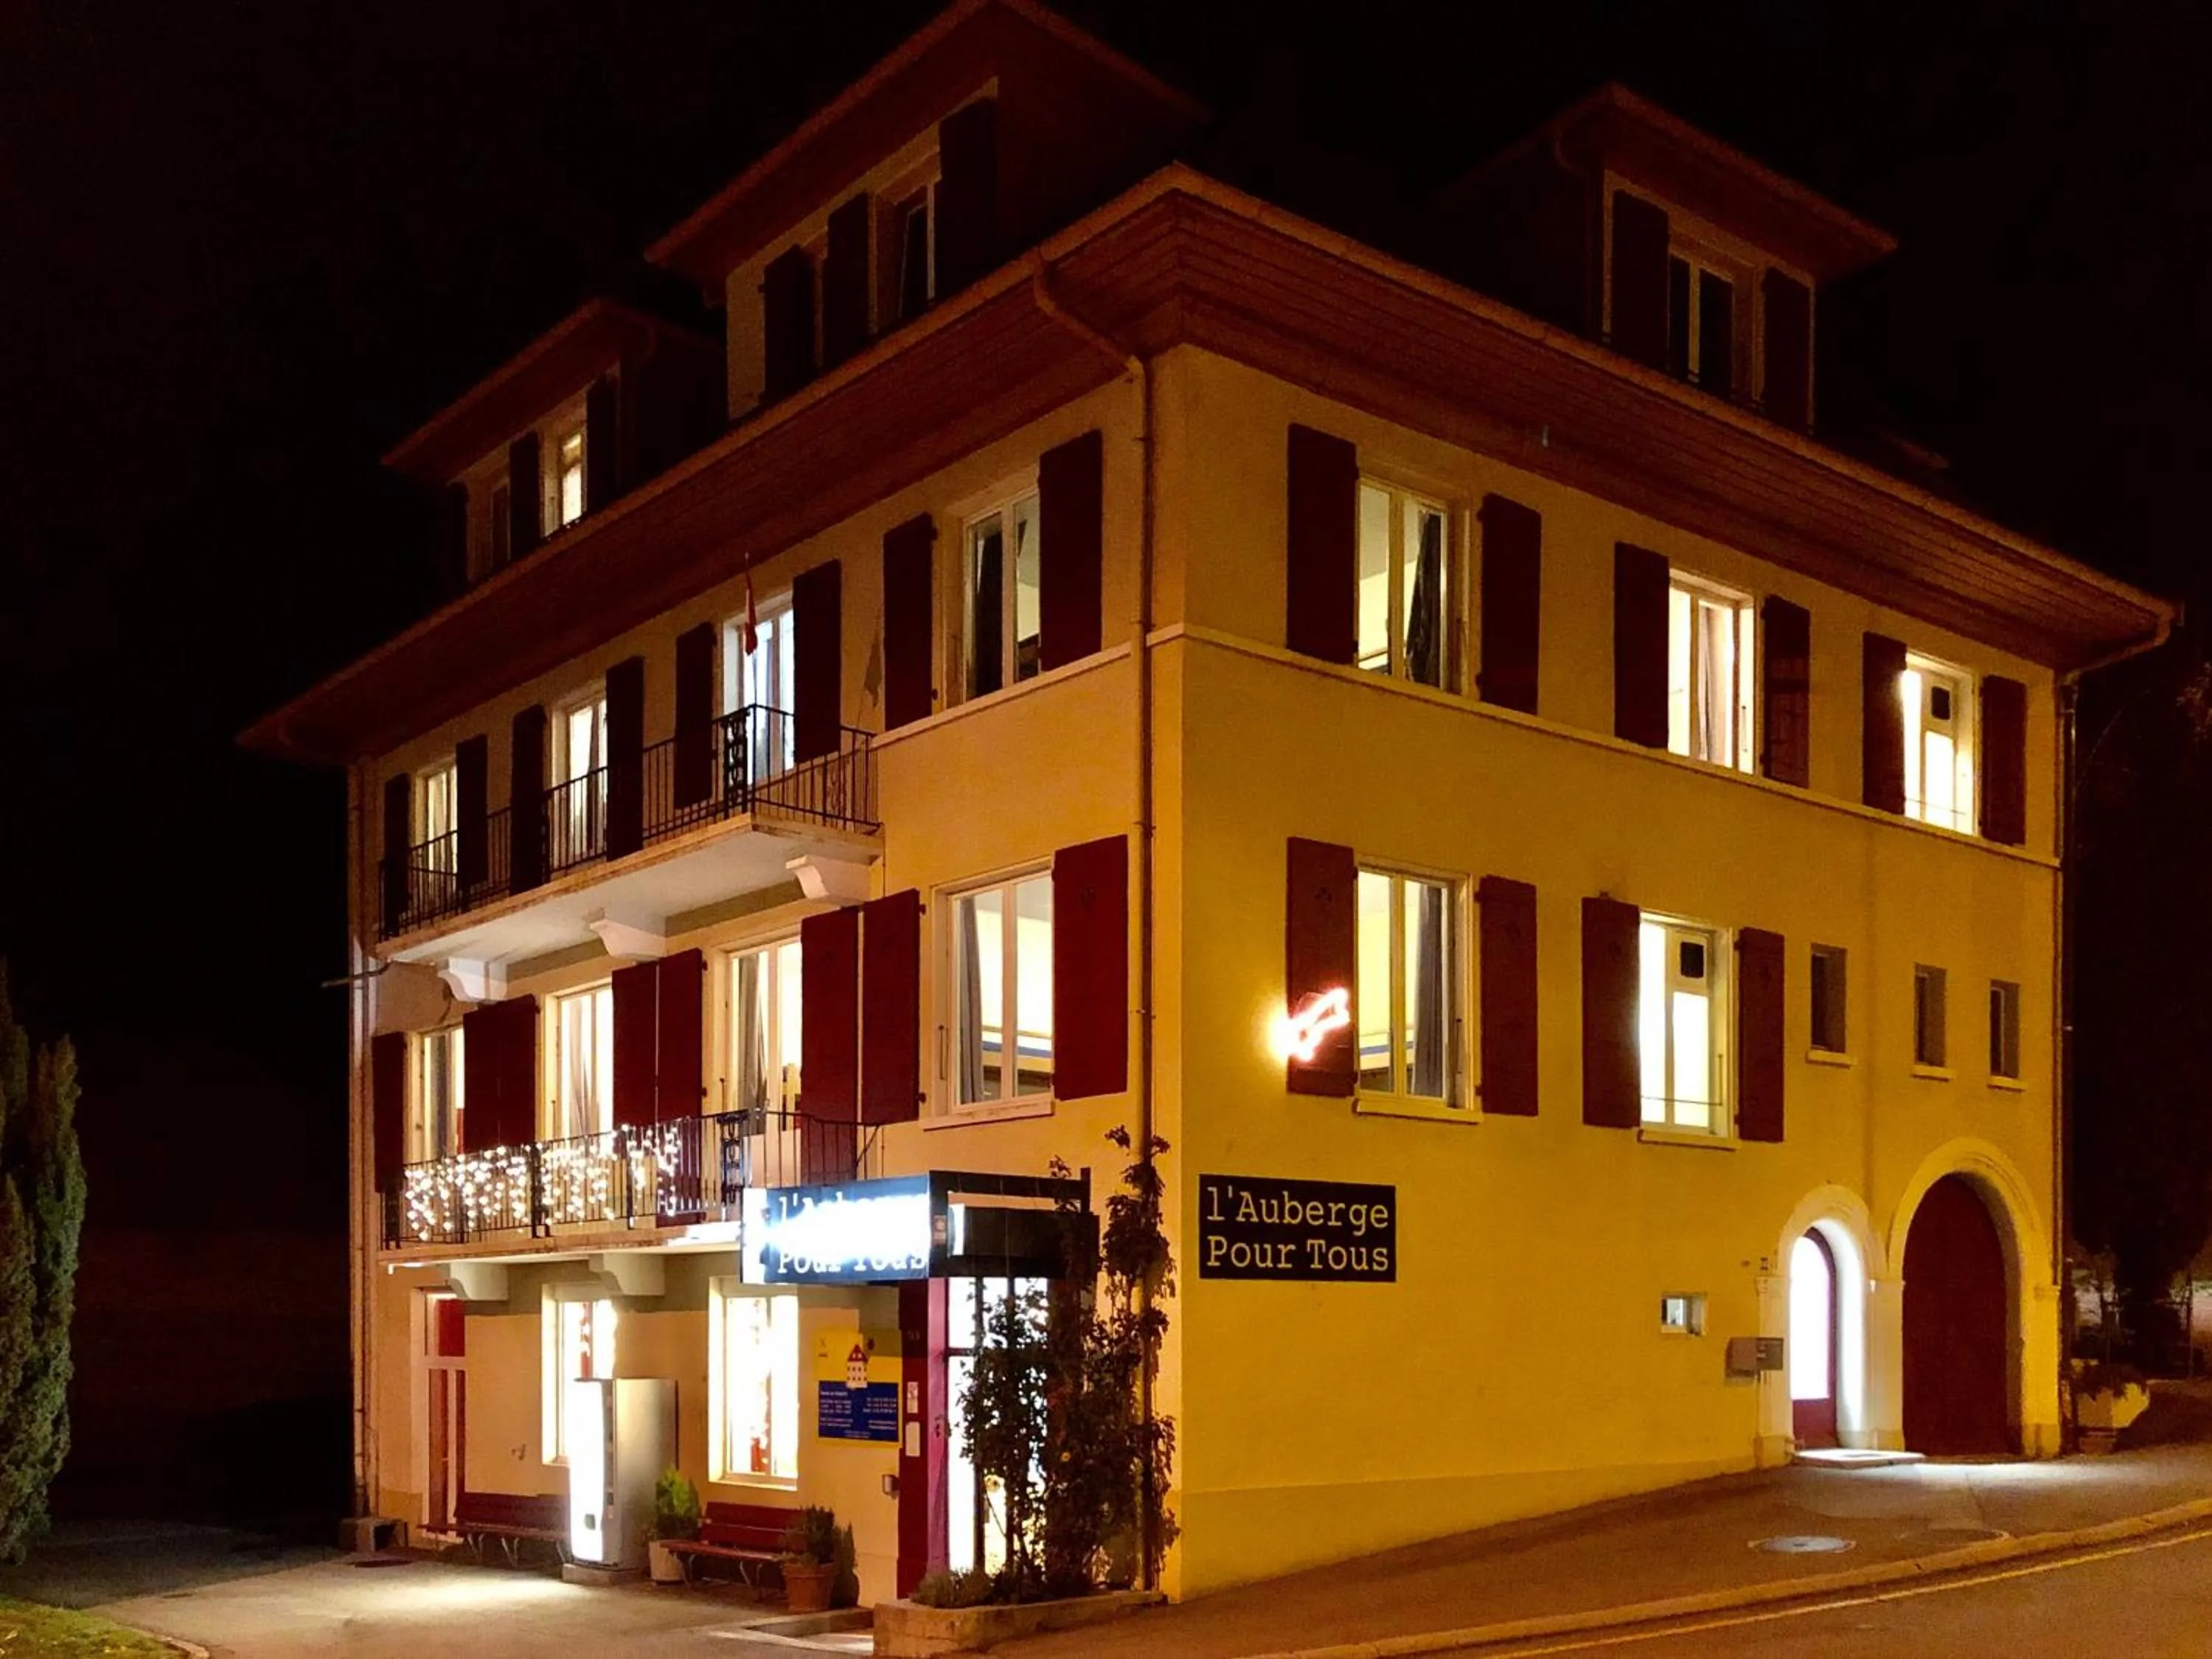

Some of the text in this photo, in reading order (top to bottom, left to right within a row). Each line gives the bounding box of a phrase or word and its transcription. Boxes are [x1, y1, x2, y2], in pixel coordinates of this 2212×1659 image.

[1206, 1185, 1389, 1237] l'Auberge
[778, 1247, 842, 1273] Pou
[1206, 1235, 1389, 1271] Pour Tous
